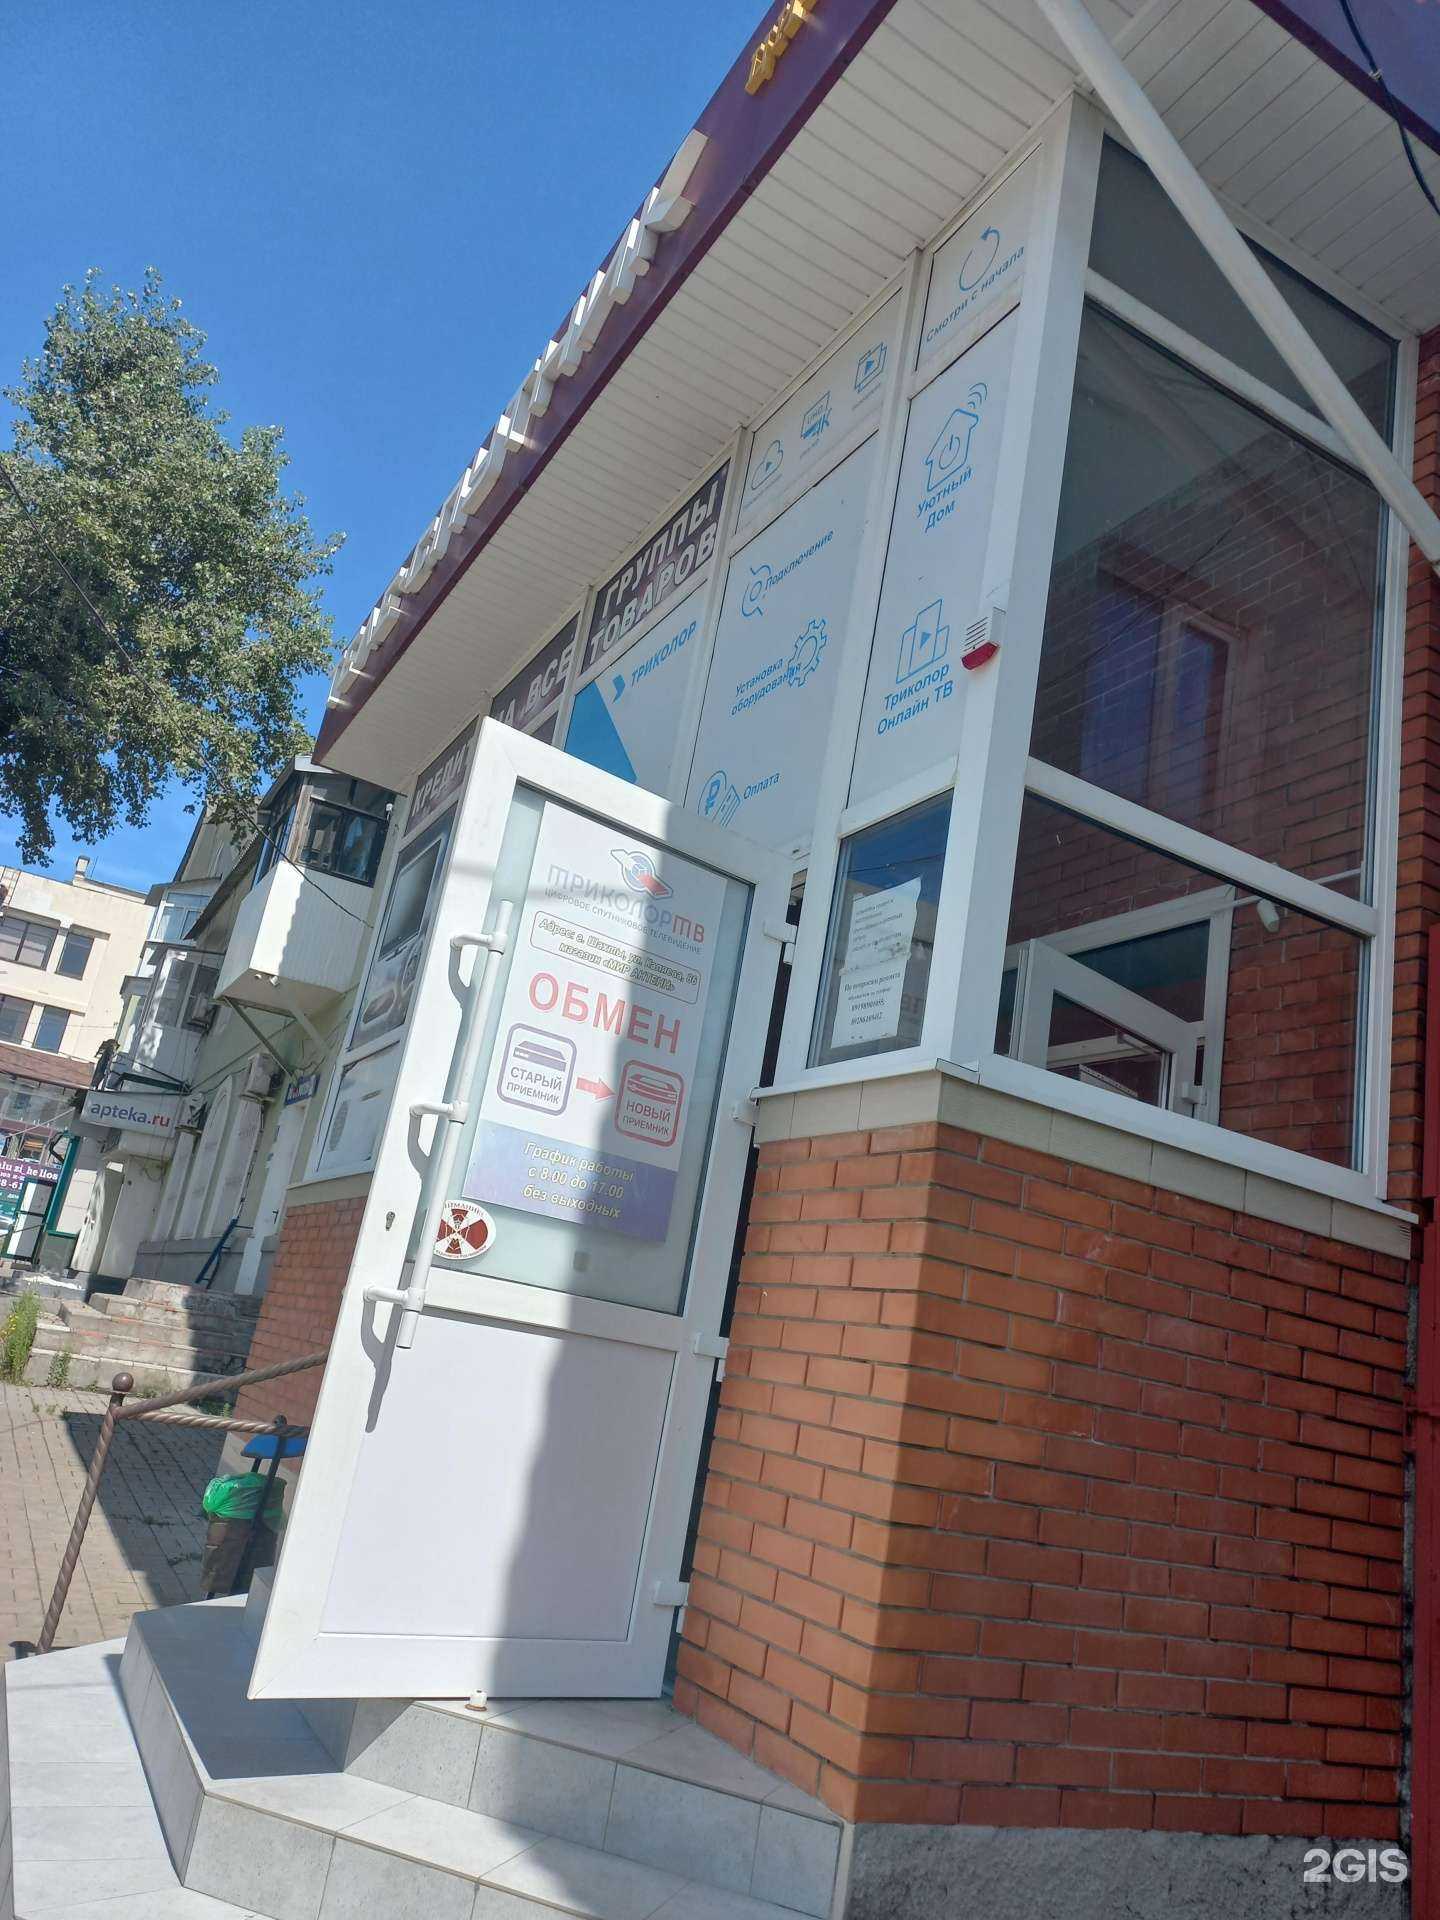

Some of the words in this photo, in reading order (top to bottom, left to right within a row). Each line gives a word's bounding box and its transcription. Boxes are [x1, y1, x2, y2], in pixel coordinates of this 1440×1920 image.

[926, 299, 968, 342] Смотри
[971, 290, 978, 300] с
[981, 247, 1024, 292] начала
[917, 467, 972, 517] Уютный
[925, 501, 955, 532] Дом
[602, 480, 719, 618] ГРУППЫ
[765, 529, 835, 592] Подключение
[589, 521, 718, 665] ТОВАРОВ
[631, 620, 697, 687] ТРИКОЛОР
[525, 639, 576, 713] ВСЕ
[735, 658, 783, 697] Установка
[884, 664, 950, 711] Триколор
[877, 696, 930, 735] Онлайн
[935, 680, 953, 702] ТВ
[412, 742, 468, 816] КРЕДИ
[743, 772, 781, 800] Оплата
[538, 917, 576, 941] Адрес:
[559, 942, 602, 966] магазин
[528, 972, 682, 1054] ОБМЕН
[506, 1081, 561, 1105] ПРИЕМНИК
[510, 1066, 563, 1091] СТАРЫЙ
[90, 1102, 171, 1128] apteka.ru
[623, 1115, 670, 1136] ПРИЕМНИК
[626, 1100, 672, 1123] НОВЫЙ
[524, 1142, 577, 1169] График
[578, 1156, 634, 1183] работы
[528, 1167, 537, 1178] с
[570, 1175, 588, 1190] до
[522, 1184, 547, 1202] без
[551, 1194, 621, 1218] выходных
